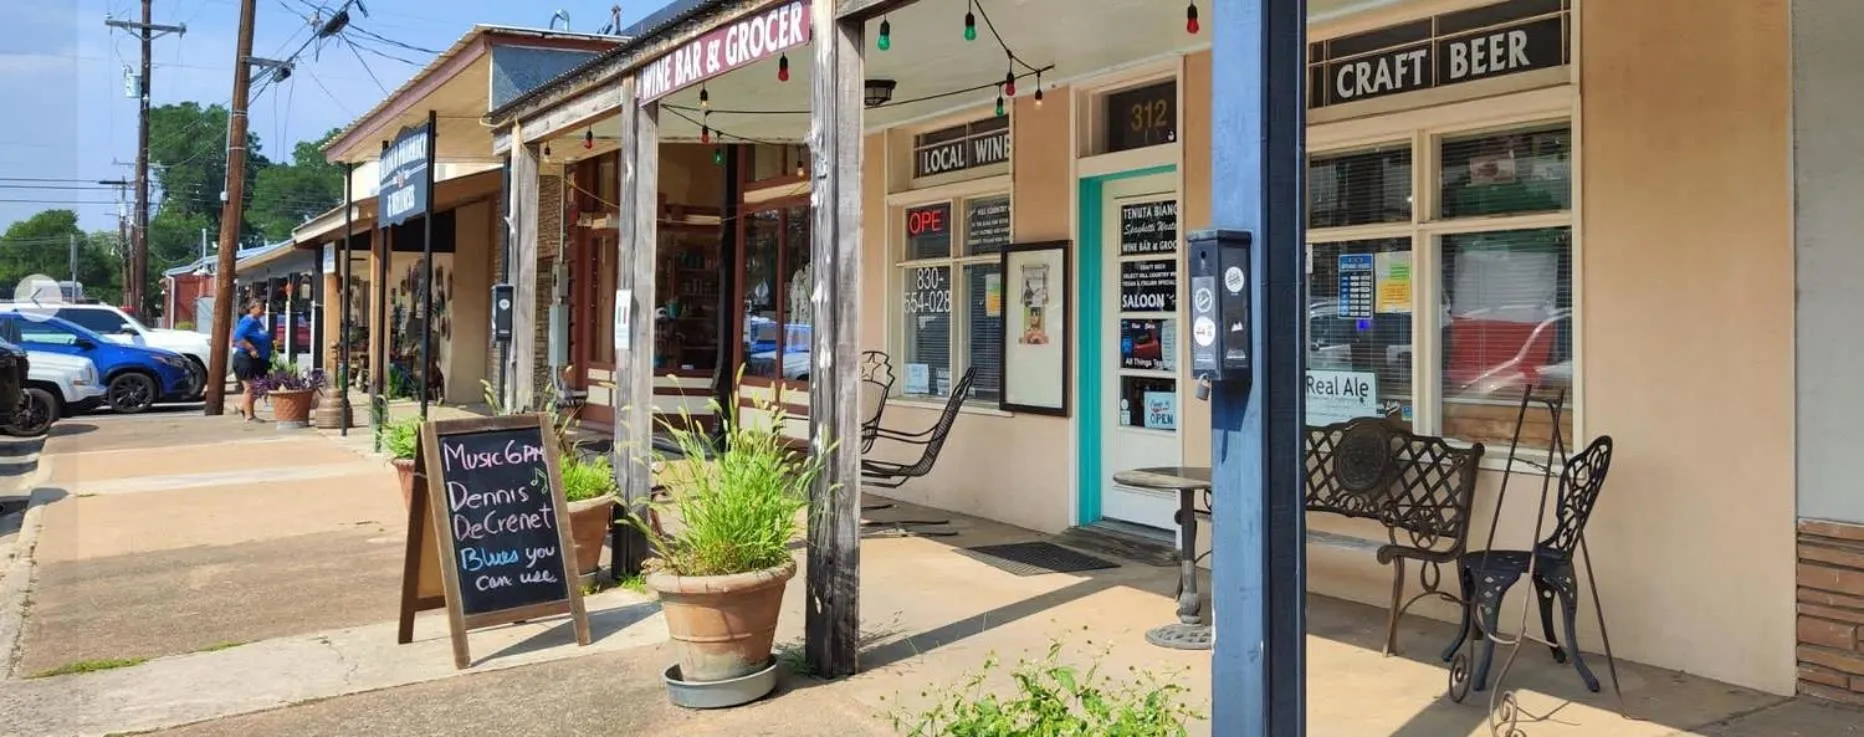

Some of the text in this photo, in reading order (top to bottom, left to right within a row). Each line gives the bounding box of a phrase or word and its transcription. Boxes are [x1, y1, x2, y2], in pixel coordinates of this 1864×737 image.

[642, 1, 804, 100] WINE BAR & GROCER
[1336, 30, 1531, 98] CRAFT BEER
[1131, 99, 1167, 130] 312
[924, 144, 965, 173] LOCAL
[909, 210, 942, 234] OPE
[1123, 206, 1153, 221] TENUTA
[1122, 242, 1139, 253] WINE
[1140, 241, 1152, 253] BAR
[917, 267, 944, 289] 830-
[1122, 293, 1166, 309] SALOON
[1306, 375, 1369, 397] Real Ale
[1150, 414, 1174, 425] OPEN
[443, 439, 548, 472] Music 6PM
[447, 481, 530, 512] Dennis
[454, 503, 552, 541] DeCrenet
[460, 547, 519, 571] Blues
[525, 545, 555, 569] you
[475, 575, 513, 592] can
